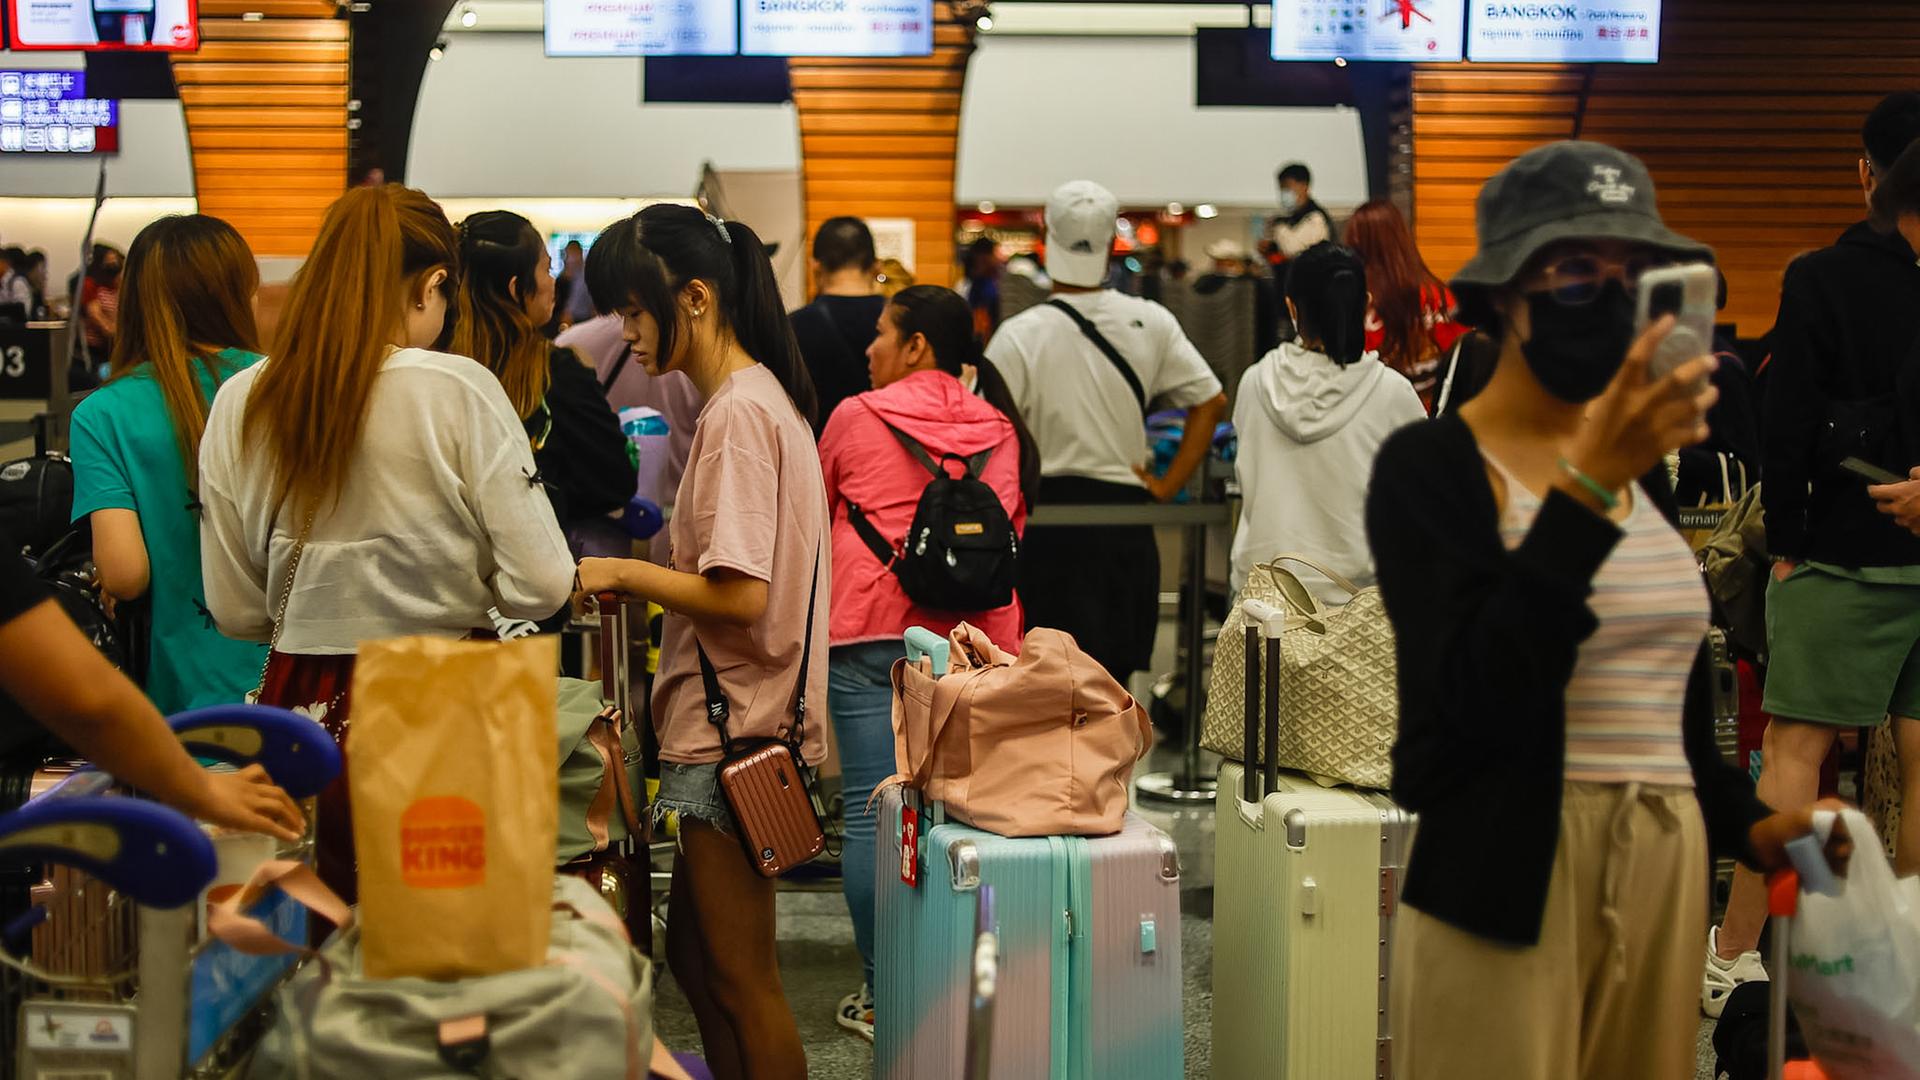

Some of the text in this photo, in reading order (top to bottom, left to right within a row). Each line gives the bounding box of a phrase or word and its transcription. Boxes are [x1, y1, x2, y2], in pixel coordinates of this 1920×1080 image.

[1486, 5, 1578, 21] BANGKOK
[0, 346, 26, 378] 3
[402, 825, 484, 843] BURGER
[402, 846, 485, 871] KING
